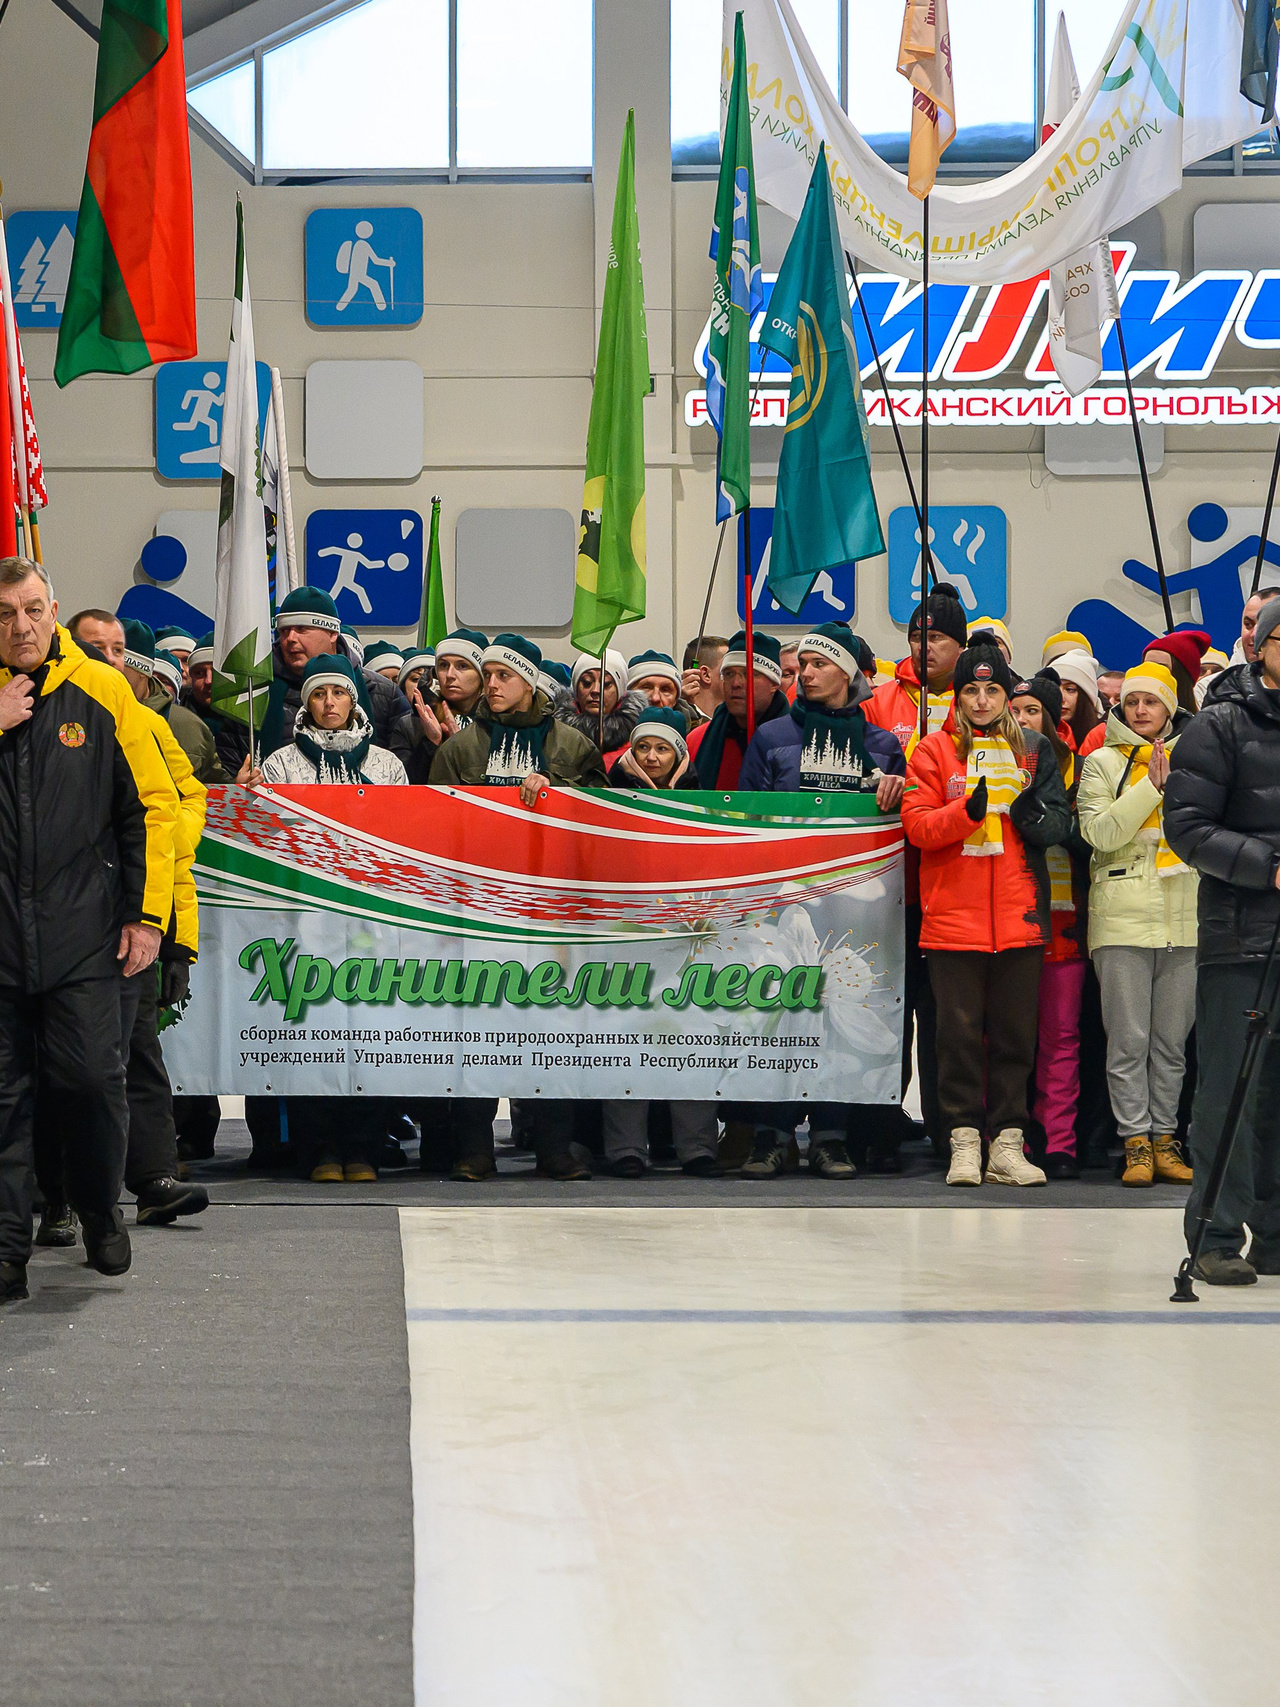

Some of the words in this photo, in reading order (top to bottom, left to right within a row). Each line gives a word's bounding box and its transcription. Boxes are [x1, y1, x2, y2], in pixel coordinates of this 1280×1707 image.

[238, 937, 651, 1021] Хранители
[661, 962, 824, 1009] леса
[240, 1026, 307, 1043] сборная
[310, 1030, 381, 1043] команда
[384, 1026, 482, 1045] работников
[484, 1030, 640, 1047] природоохранных
[642, 1033, 654, 1045] и
[657, 1031, 821, 1047] лесохозяйственных
[239, 1049, 346, 1066] учреждений
[355, 1050, 455, 1067] Управления
[462, 1055, 523, 1068] делами
[531, 1052, 632, 1070] Президента
[639, 1053, 739, 1070] Республики
[747, 1055, 819, 1073] Беларусь
